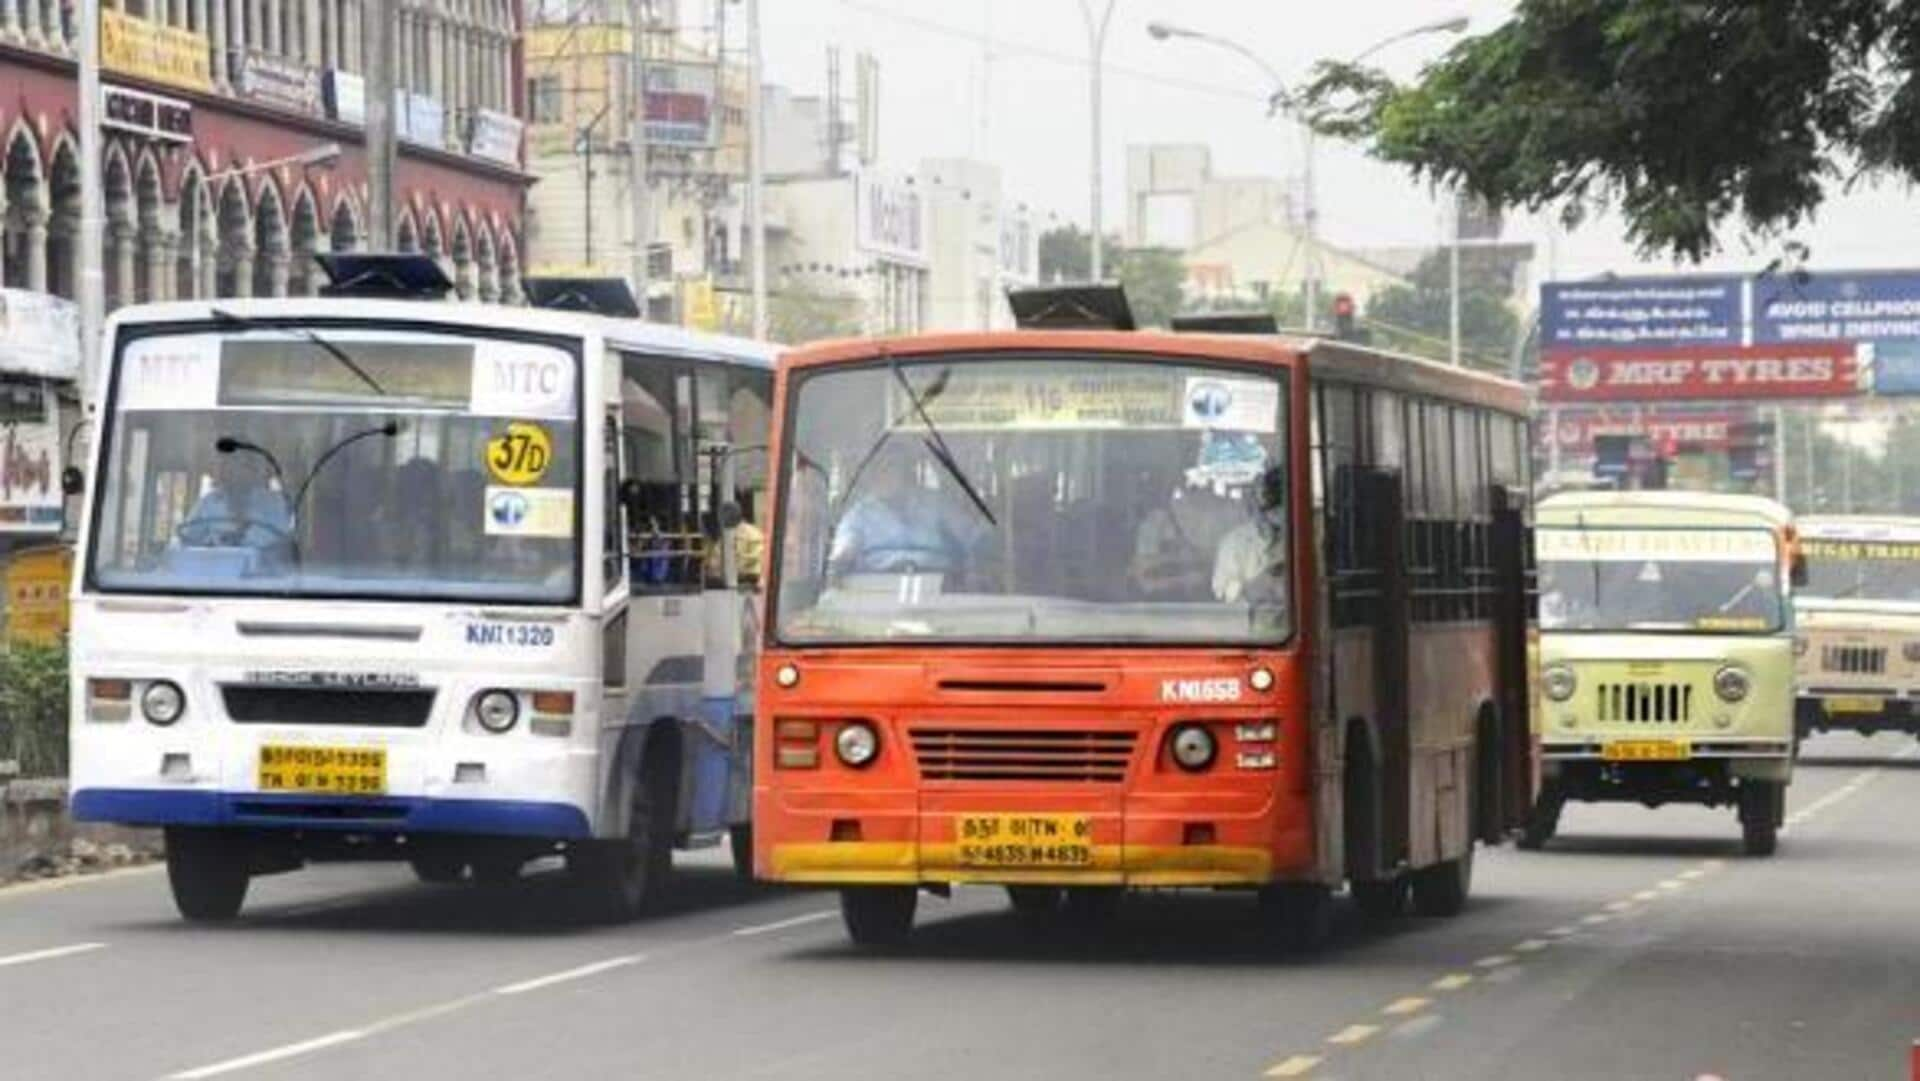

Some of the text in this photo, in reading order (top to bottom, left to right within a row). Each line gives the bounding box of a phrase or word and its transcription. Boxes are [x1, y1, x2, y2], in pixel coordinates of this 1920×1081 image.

[1767, 302, 1826, 320] AVOID
[1779, 322, 1840, 339] WHILE
[494, 362, 560, 394] MTC
[1608, 356, 1833, 385] MRF TYRES
[495, 434, 545, 473] 37D
